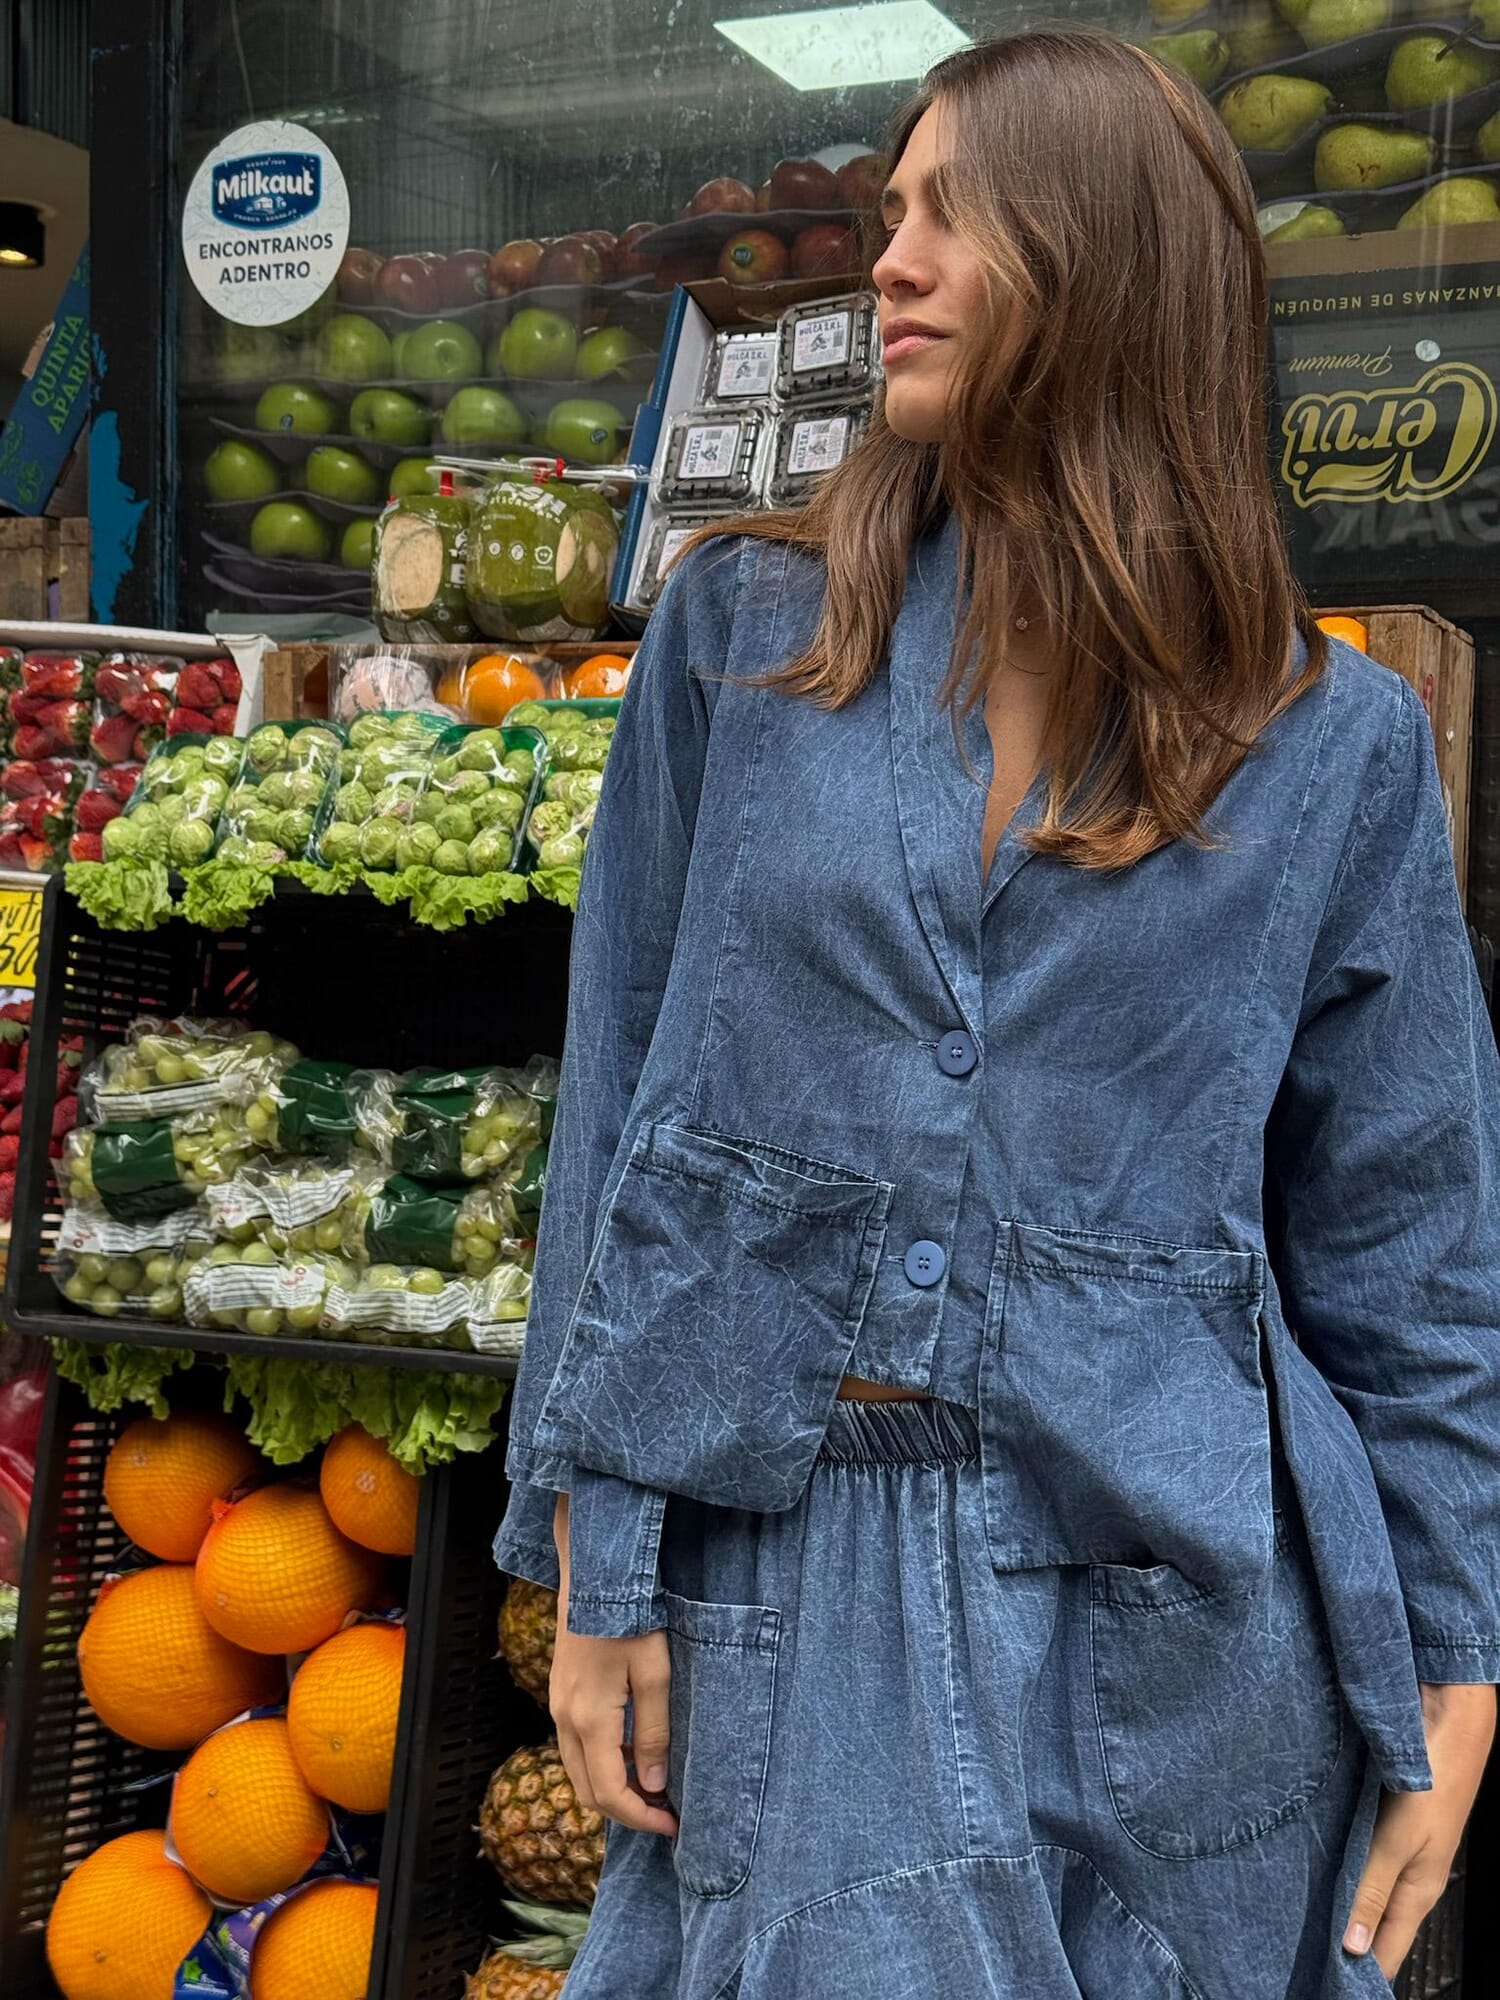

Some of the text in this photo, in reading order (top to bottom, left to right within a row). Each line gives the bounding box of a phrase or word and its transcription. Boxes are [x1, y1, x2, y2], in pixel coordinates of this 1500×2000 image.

[217, 168, 314, 205] Milkaut
[199, 233, 333, 260] ENCONTRANOS
[219, 261, 311, 284] ADENTRO
[1275, 285, 1500, 316] ANZANAS DE NEUQUÉN
[31, 316, 85, 408] QUINTA
[1288, 345, 1393, 377] Premium
[48, 330, 90, 434] APARIC
[1290, 370, 1490, 492] Cervi
